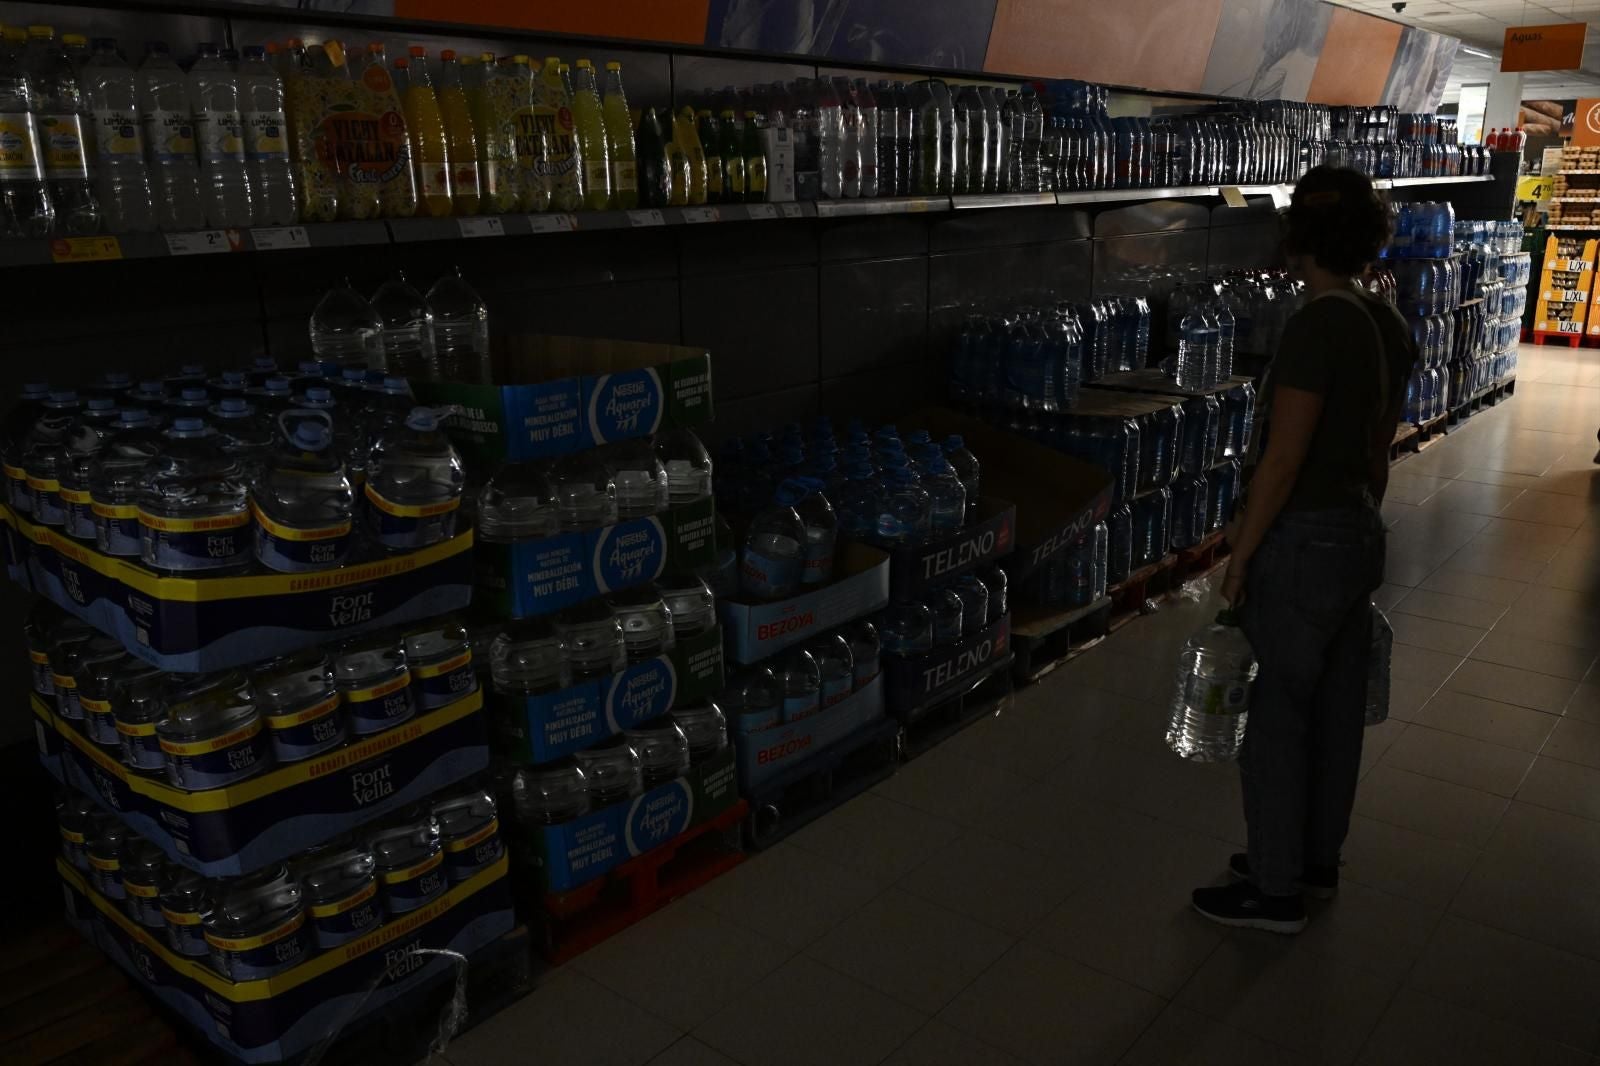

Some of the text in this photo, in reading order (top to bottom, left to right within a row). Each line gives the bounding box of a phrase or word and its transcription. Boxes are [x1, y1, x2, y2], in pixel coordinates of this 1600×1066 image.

[1511, 32, 1543, 45] Aguas
[1565, 291, 1584, 301] L/XL
[1560, 322, 1579, 332] L/XL
[605, 392, 652, 416] Aquarel
[609, 539, 655, 567] Aquarel
[922, 530, 995, 580] TELENO
[331, 592, 375, 613] Font
[533, 583, 554, 598] MUY
[329, 607, 372, 627] Vella
[758, 611, 813, 641] BEZOYA
[923, 639, 992, 693] TELENO
[550, 732, 568, 744] MUY
[758, 735, 812, 765] BEZOYA
[352, 764, 392, 791] Font
[352, 780, 394, 805] Vella
[384, 938, 423, 966] Font
[384, 955, 424, 981] Vella
